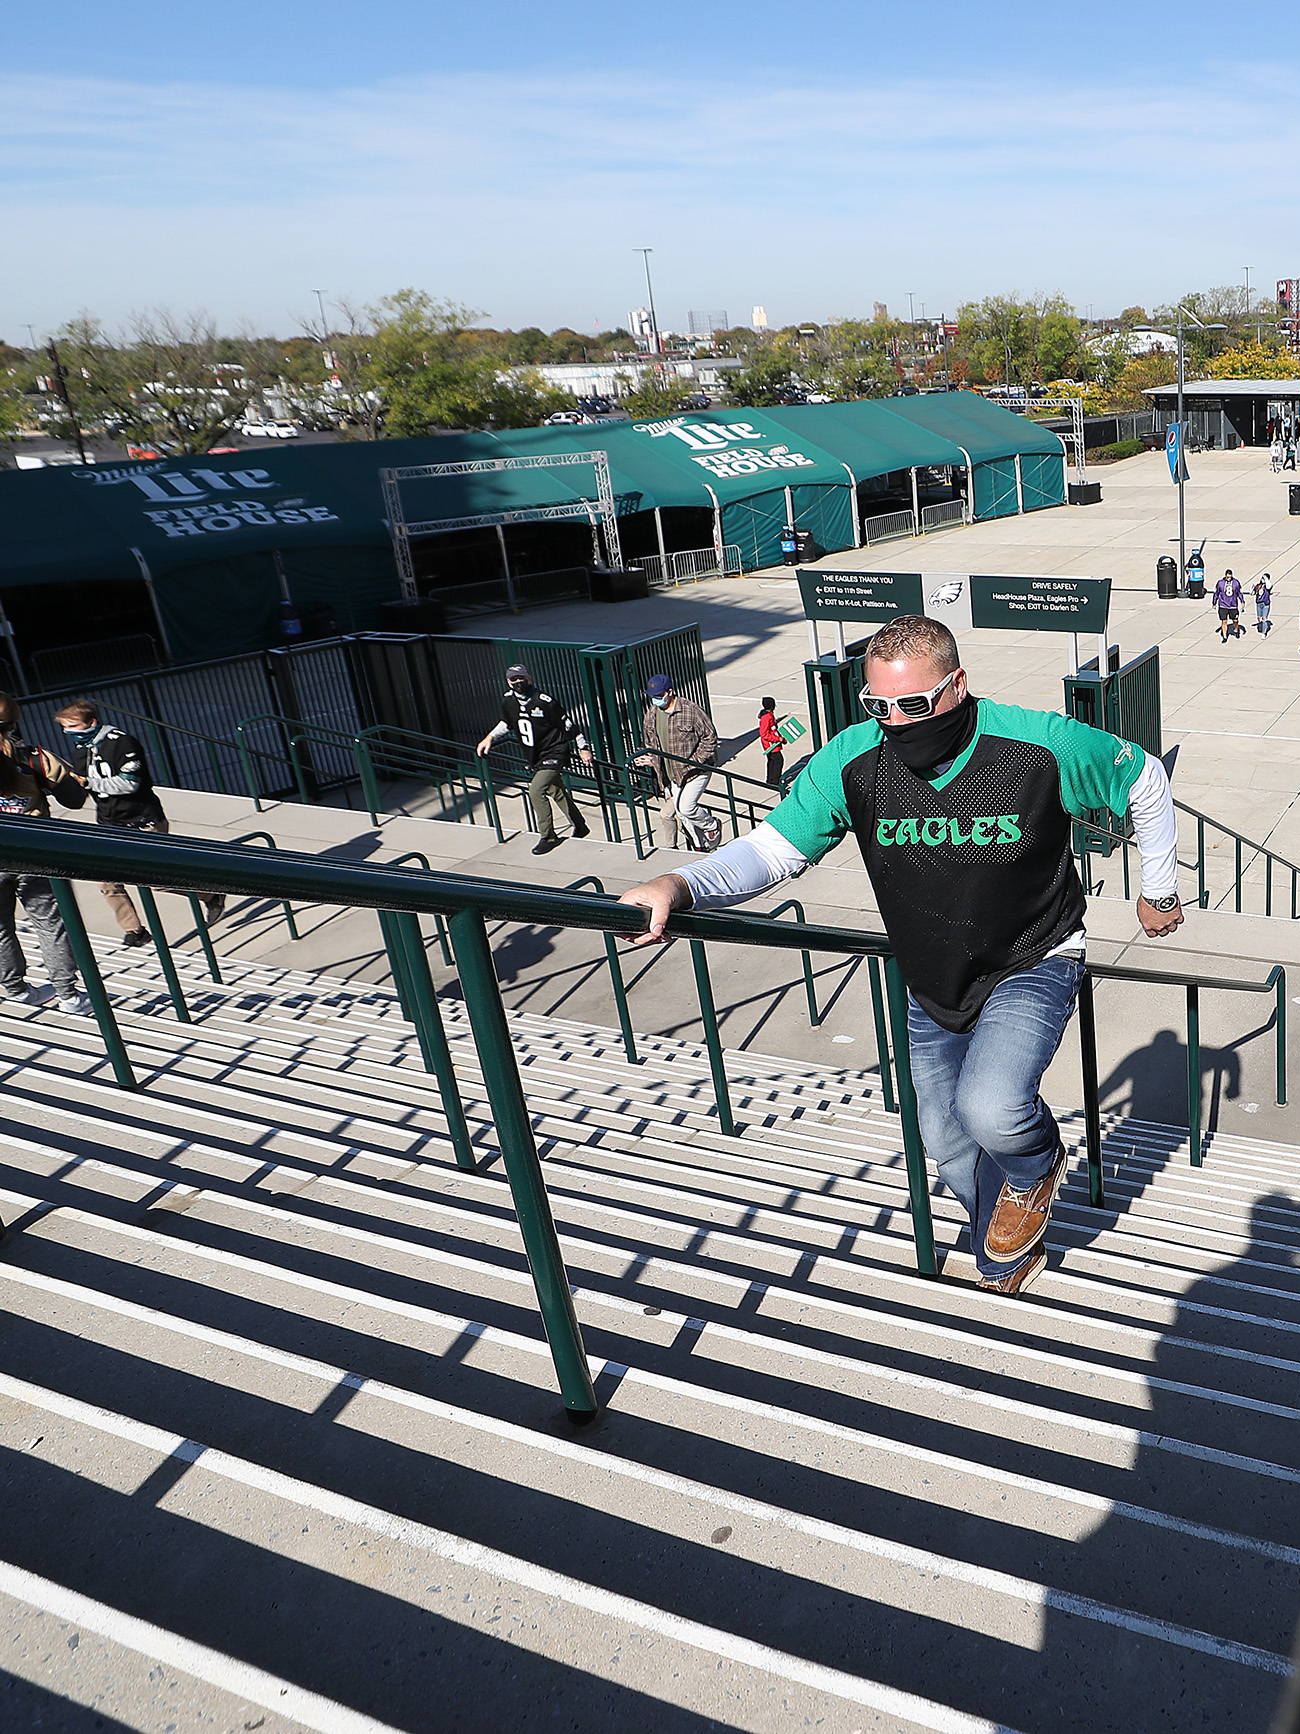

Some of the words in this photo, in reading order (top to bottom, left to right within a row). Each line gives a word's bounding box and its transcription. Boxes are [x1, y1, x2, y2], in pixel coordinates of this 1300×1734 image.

[632, 416, 688, 438] Miller
[668, 421, 763, 450] Lite
[690, 448, 765, 468] FIELD
[704, 452, 815, 479] HOUSE
[71, 462, 168, 486] Miller
[126, 467, 276, 502] Lite
[142, 499, 267, 523] FIELD
[154, 505, 340, 538] HOUSE
[822, 574, 834, 582] THE
[834, 575, 858, 583] EAGLES
[858, 575, 879, 584] THANK
[879, 576, 894, 584] YOU
[1032, 582, 1052, 590] DRIVE
[1052, 582, 1078, 591] SAFELY
[856, 587, 873, 595] Street
[992, 592, 1027, 601] HeadHouse
[1027, 594, 1046, 602] Plaza,
[1046, 594, 1067, 604] Eagles
[1067, 595, 1079, 603] Pro
[1225, 586, 1234, 597] 8
[824, 598, 837, 606] EXIT
[862, 600, 884, 608] Pattison
[885, 601, 899, 609] Ave.
[1008, 602, 1027, 611] Shop,
[1027, 602, 1041, 610] EXIT
[517, 718, 535, 748] 9
[876, 813, 1022, 847] EAGLES
